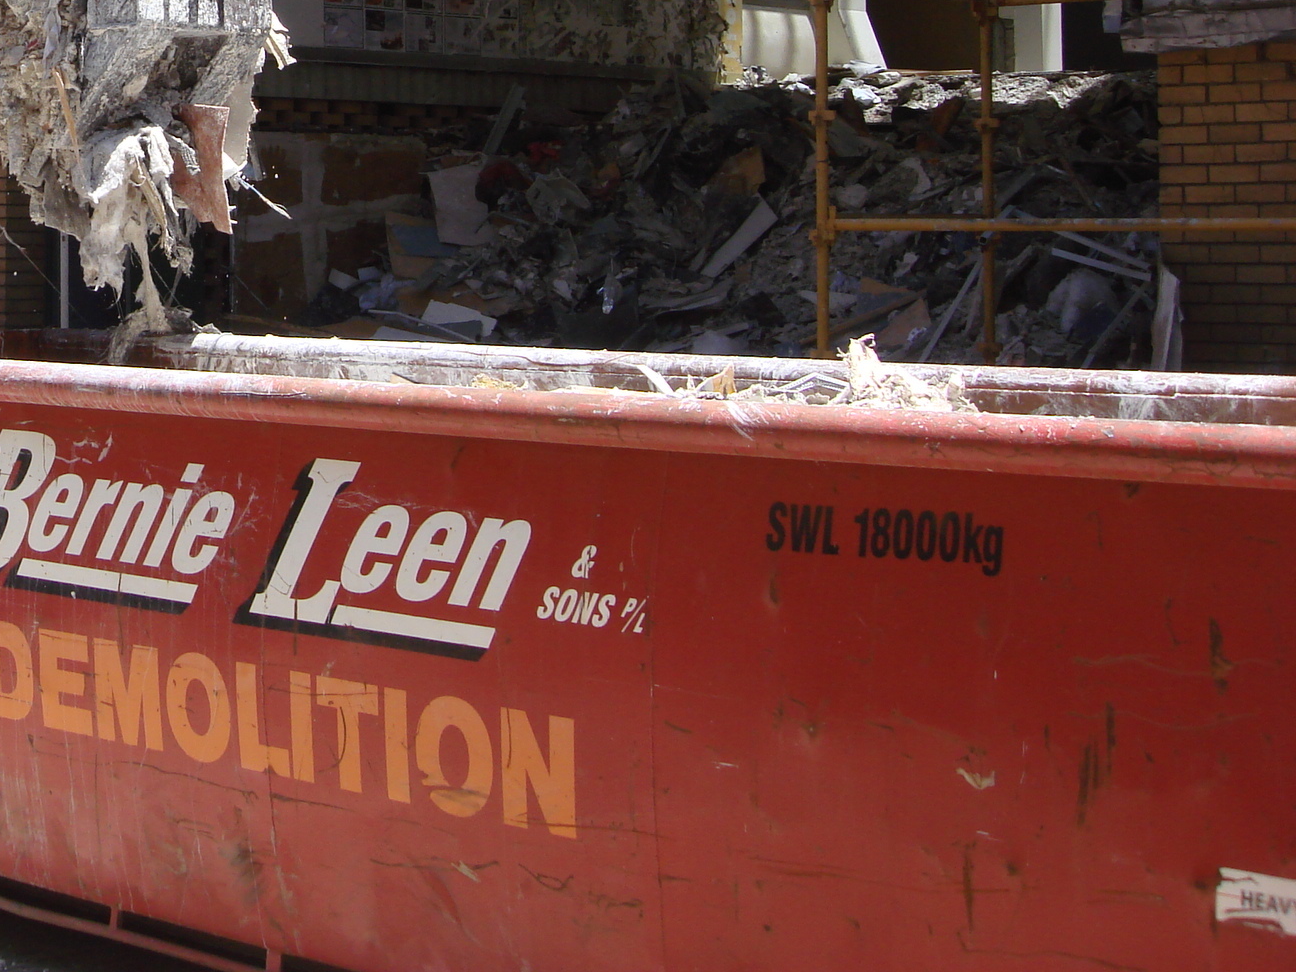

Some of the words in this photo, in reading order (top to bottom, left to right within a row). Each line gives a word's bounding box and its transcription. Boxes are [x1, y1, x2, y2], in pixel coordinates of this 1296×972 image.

[248, 457, 532, 624] Leen
[571, 544, 597, 579] &
[765, 501, 840, 555] SWL
[854, 507, 1004, 577] 18000kg
[536, 586, 617, 628] SONS
